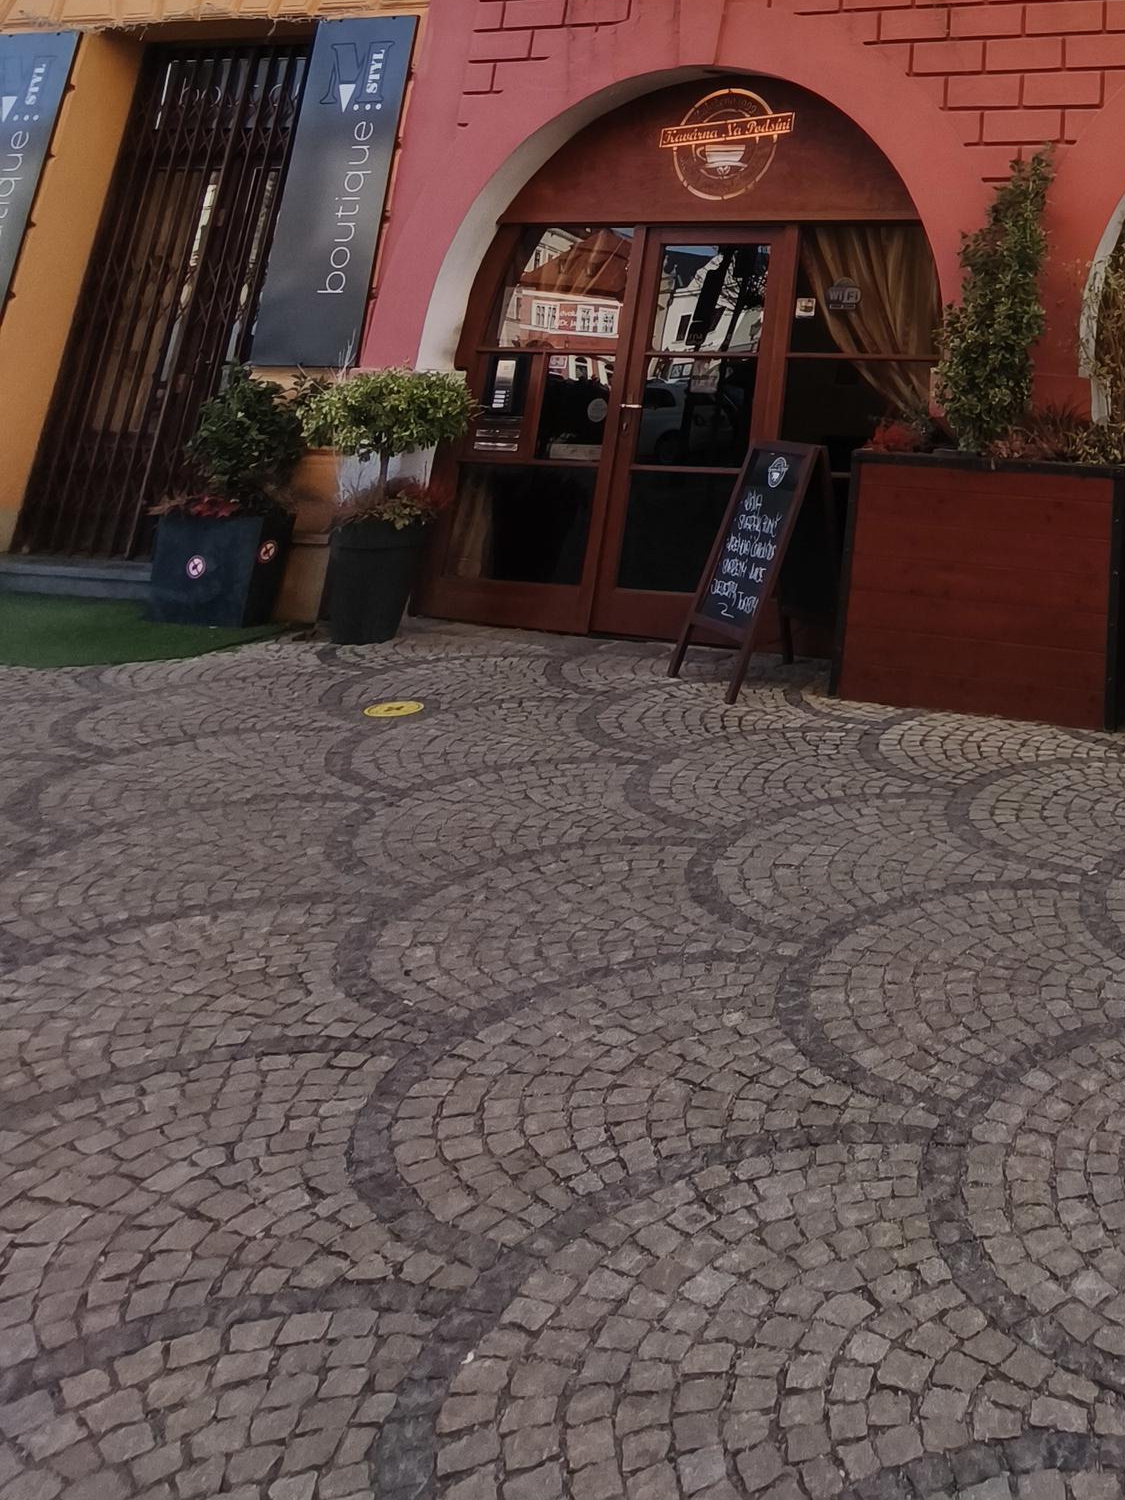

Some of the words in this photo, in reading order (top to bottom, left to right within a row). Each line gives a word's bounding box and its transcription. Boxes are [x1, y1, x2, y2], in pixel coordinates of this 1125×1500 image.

[24, 63, 47, 106] STYL
[365, 48, 386, 94] STYL
[662, 127, 719, 144] Kavárna
[721, 122, 742, 138] Na
[317, 120, 374, 294] boutique
